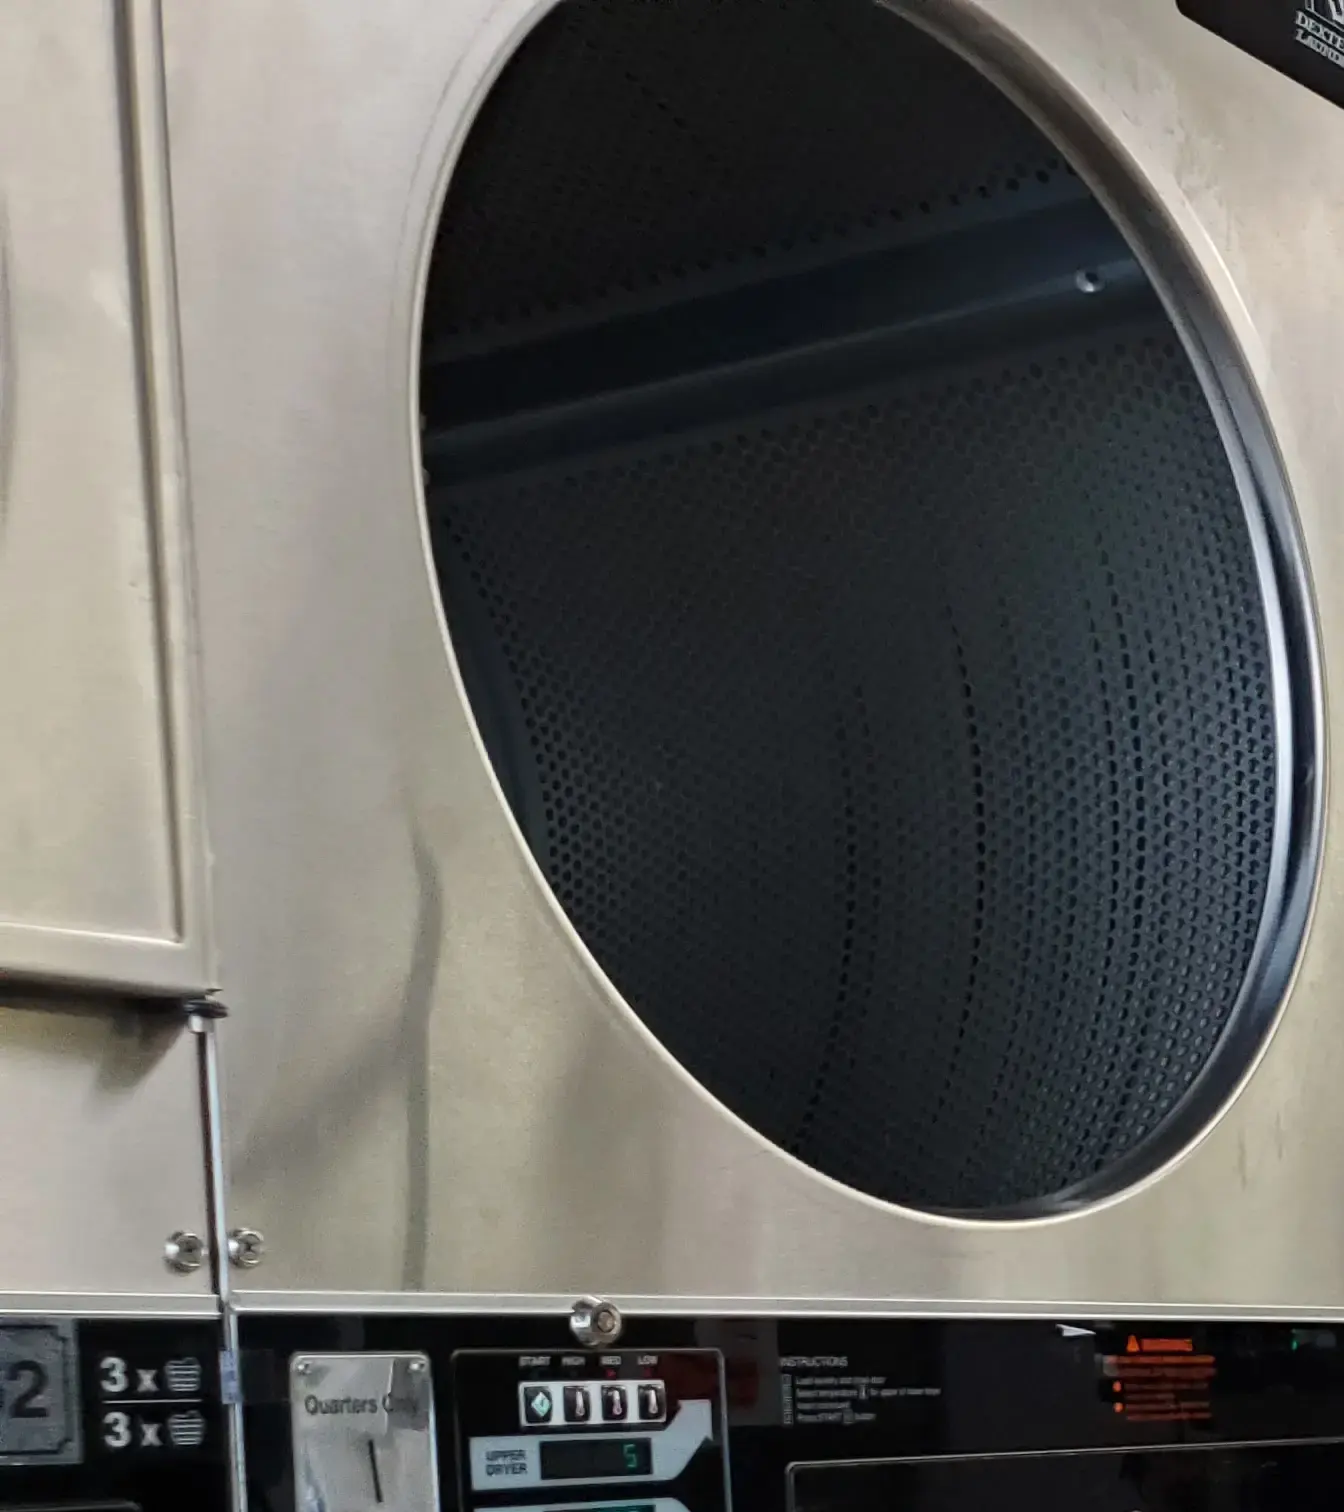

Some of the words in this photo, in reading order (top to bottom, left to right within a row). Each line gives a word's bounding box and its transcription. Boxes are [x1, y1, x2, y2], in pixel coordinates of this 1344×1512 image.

[0, 1360, 47, 1418] 2
[305, 1394, 378, 1416] Quarters
[485, 1450, 526, 1462] UPPER
[485, 1463, 528, 1477] DRYER
